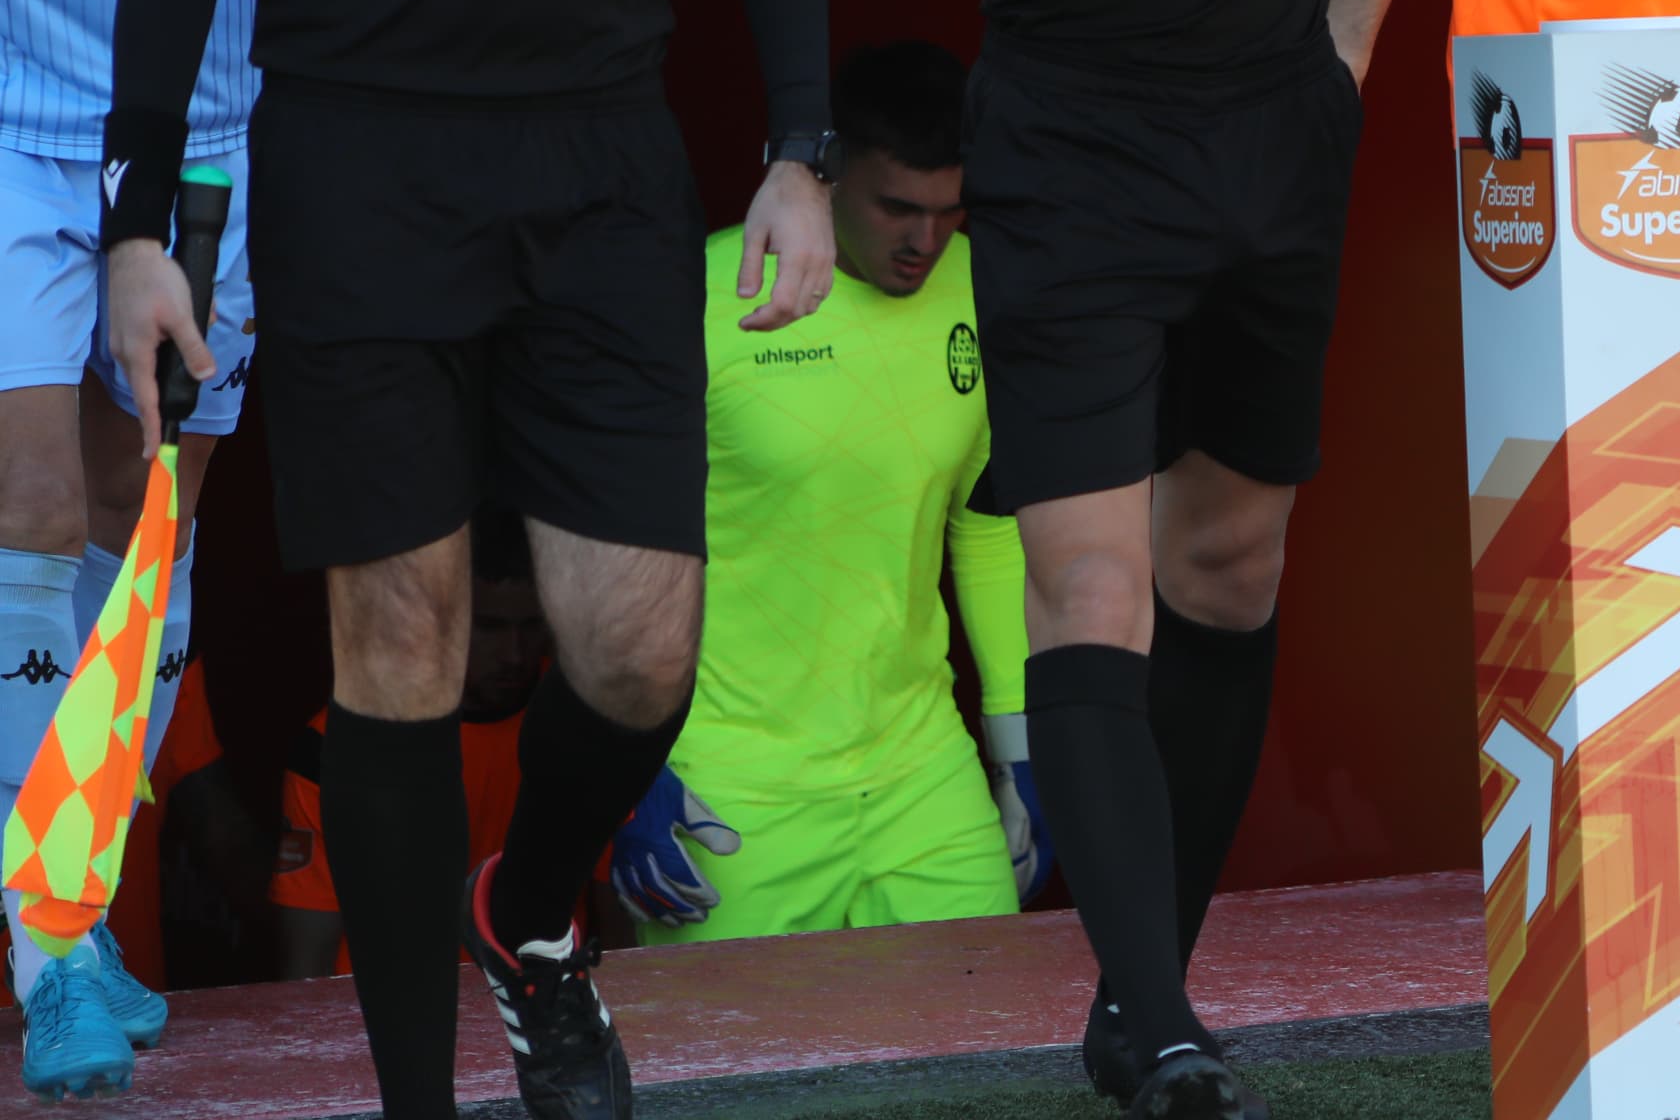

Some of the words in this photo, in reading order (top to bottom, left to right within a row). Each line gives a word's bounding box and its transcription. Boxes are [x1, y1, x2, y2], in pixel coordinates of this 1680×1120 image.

[1488, 180, 1536, 208] abissnet
[1473, 209, 1545, 253] Superiore
[754, 345, 835, 366] uhlsport
